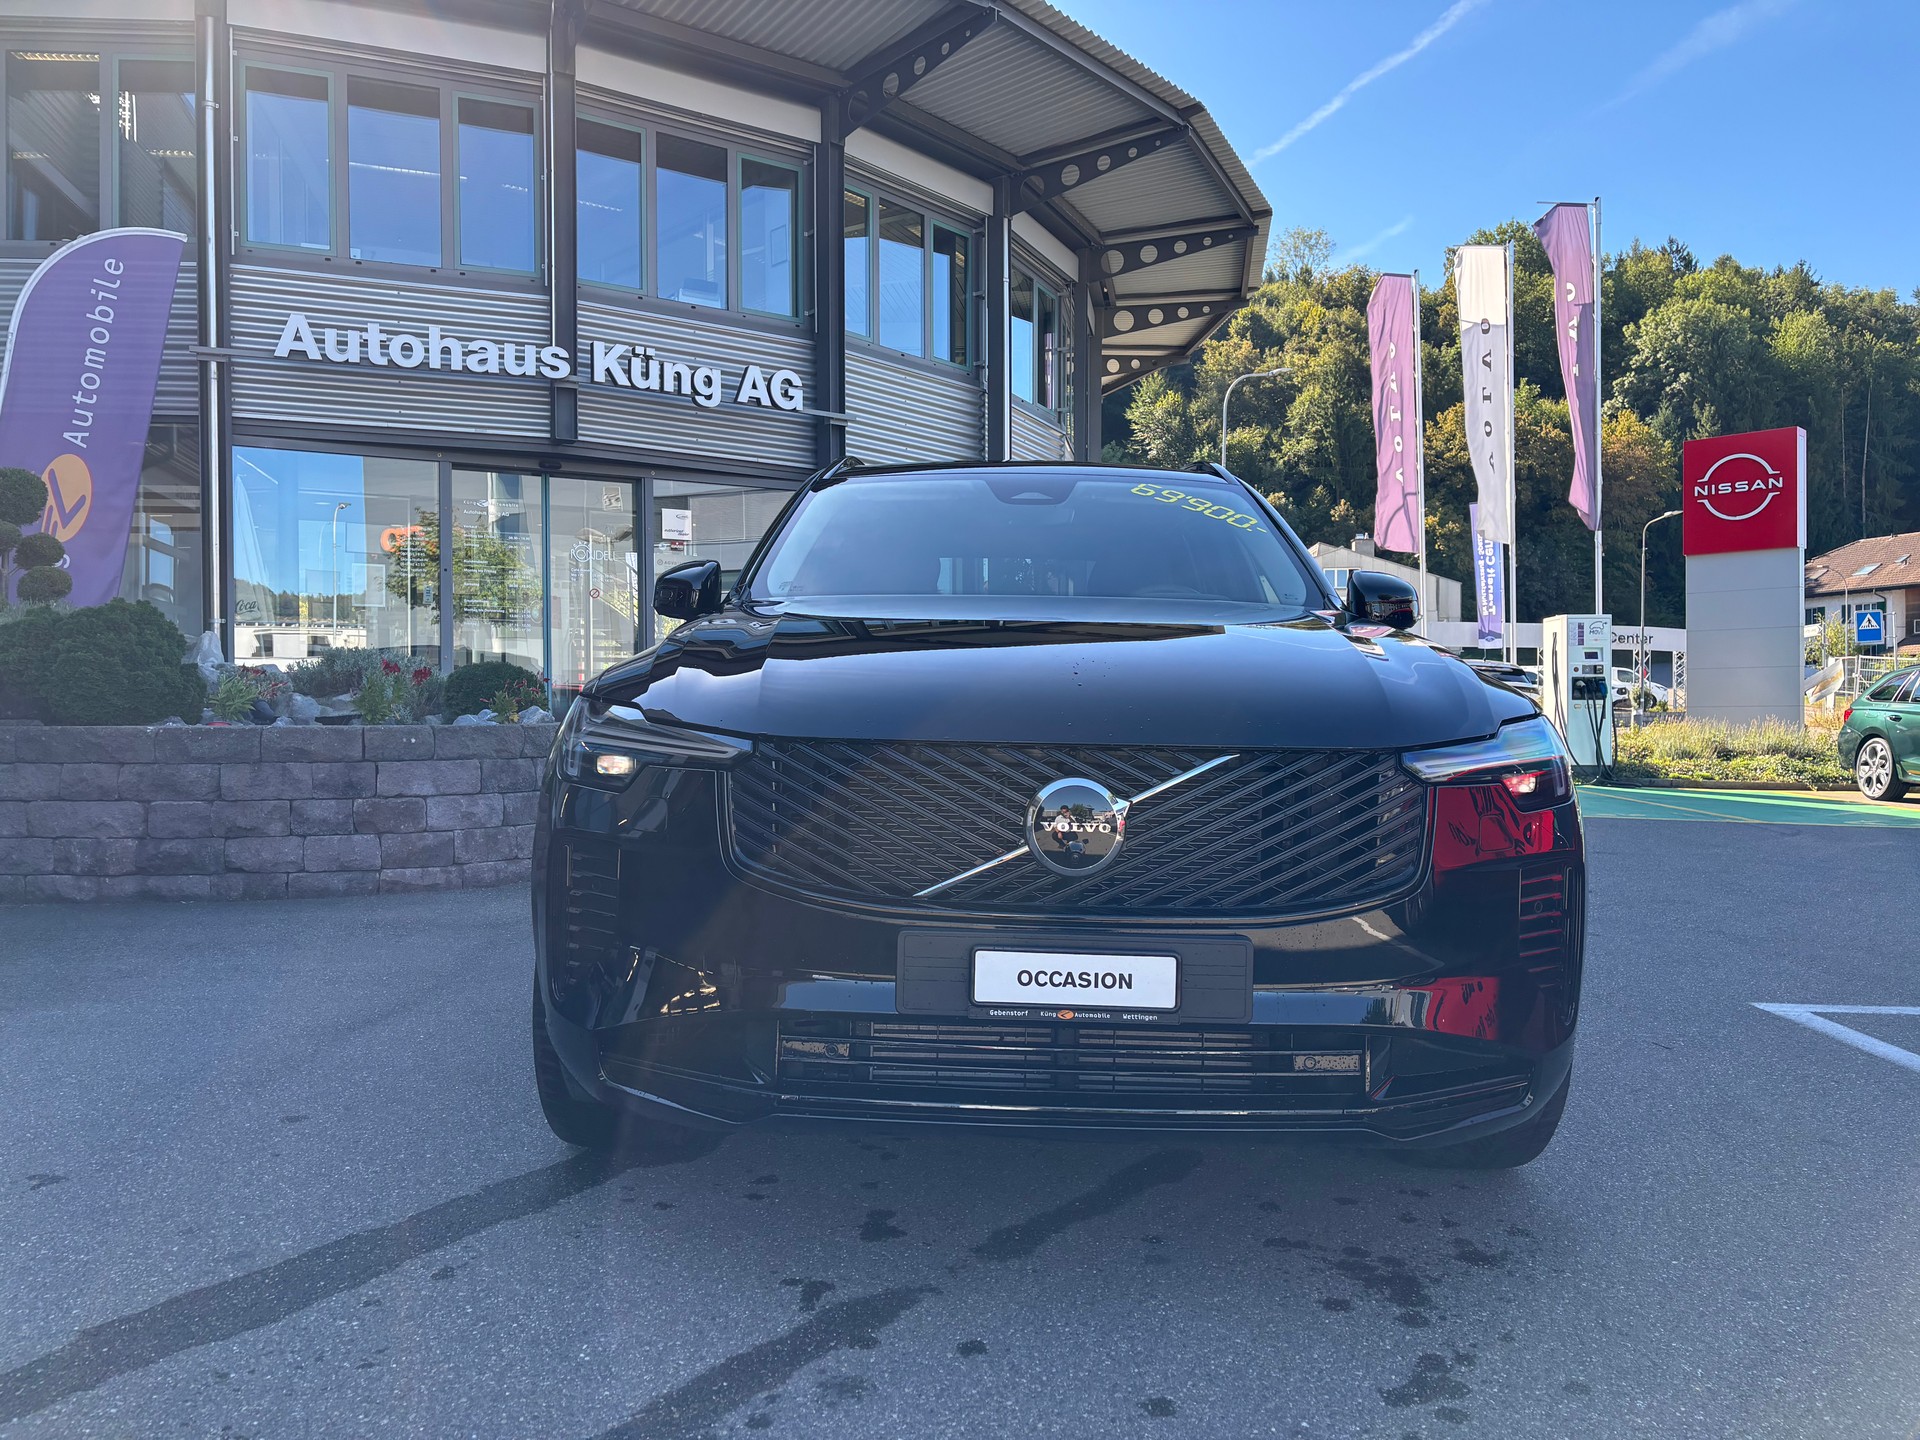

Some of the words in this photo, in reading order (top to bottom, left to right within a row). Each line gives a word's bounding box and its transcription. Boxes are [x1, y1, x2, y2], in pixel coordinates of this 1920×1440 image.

[62, 257, 125, 449] Automobile
[273, 312, 571, 380] Autohaus
[590, 340, 722, 408] Küng
[735, 364, 804, 411] AG
[1694, 476, 1783, 497] NISSAN
[1130, 483, 1267, 533] 69'900.-
[236, 599, 257, 612] Coca
[1040, 821, 1112, 834] VOLVO
[1016, 969, 1133, 990] OCCASION
[989, 1008, 1029, 1017] Gebenstorf
[1040, 1010, 1057, 1019] Küng
[1074, 1011, 1111, 1020] Automobile
[1122, 1013, 1158, 1021] Wettingen
